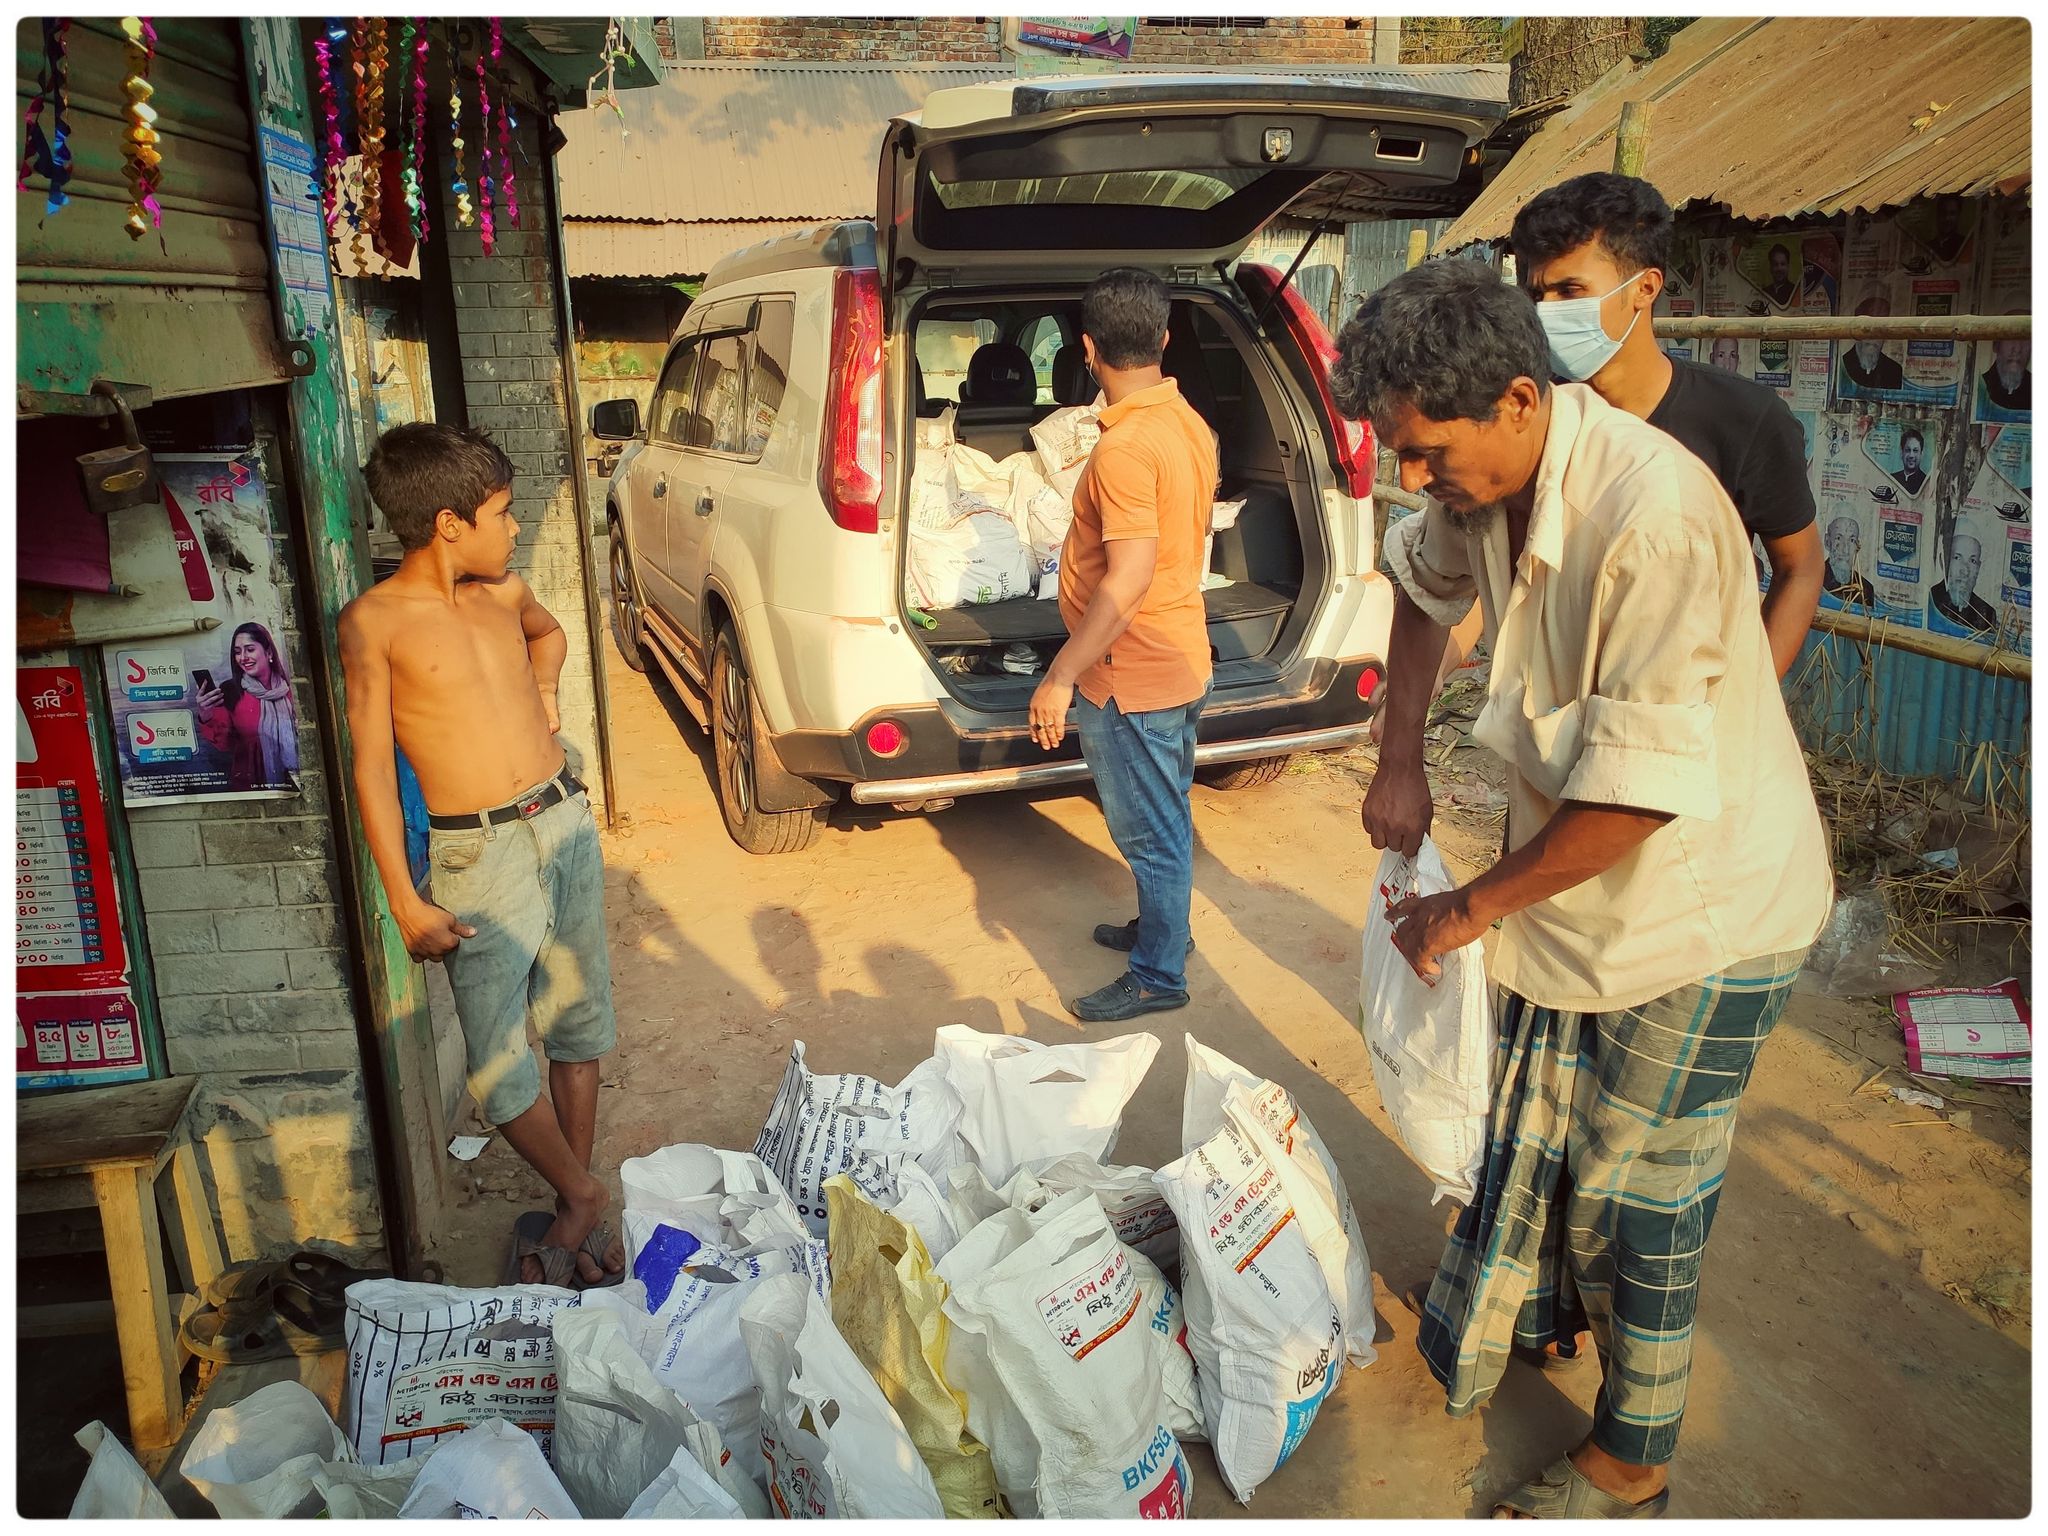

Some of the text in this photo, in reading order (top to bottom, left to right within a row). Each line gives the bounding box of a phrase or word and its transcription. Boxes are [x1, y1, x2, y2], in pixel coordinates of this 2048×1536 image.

[196, 477, 235, 504] রবি
[147, 665, 167, 677] জিবি
[32, 690, 61, 710] রবি
[156, 728, 175, 738] জিবি
[1234, 1196, 1249, 1214] এম
[1214, 1233, 1238, 1255] মিঠু
[1074, 1281, 1097, 1303] এম
[1100, 1265, 1115, 1286] এন্ড
[1086, 1293, 1113, 1317] মিঠু
[1151, 1286, 1174, 1335] BKF
[661, 1328, 686, 1372] বাংলাদেশ।
[434, 1373, 536, 1390] এম এন্ড এম
[440, 1390, 477, 1406] মিঠু
[1122, 1424, 1172, 1492] BKFSG
